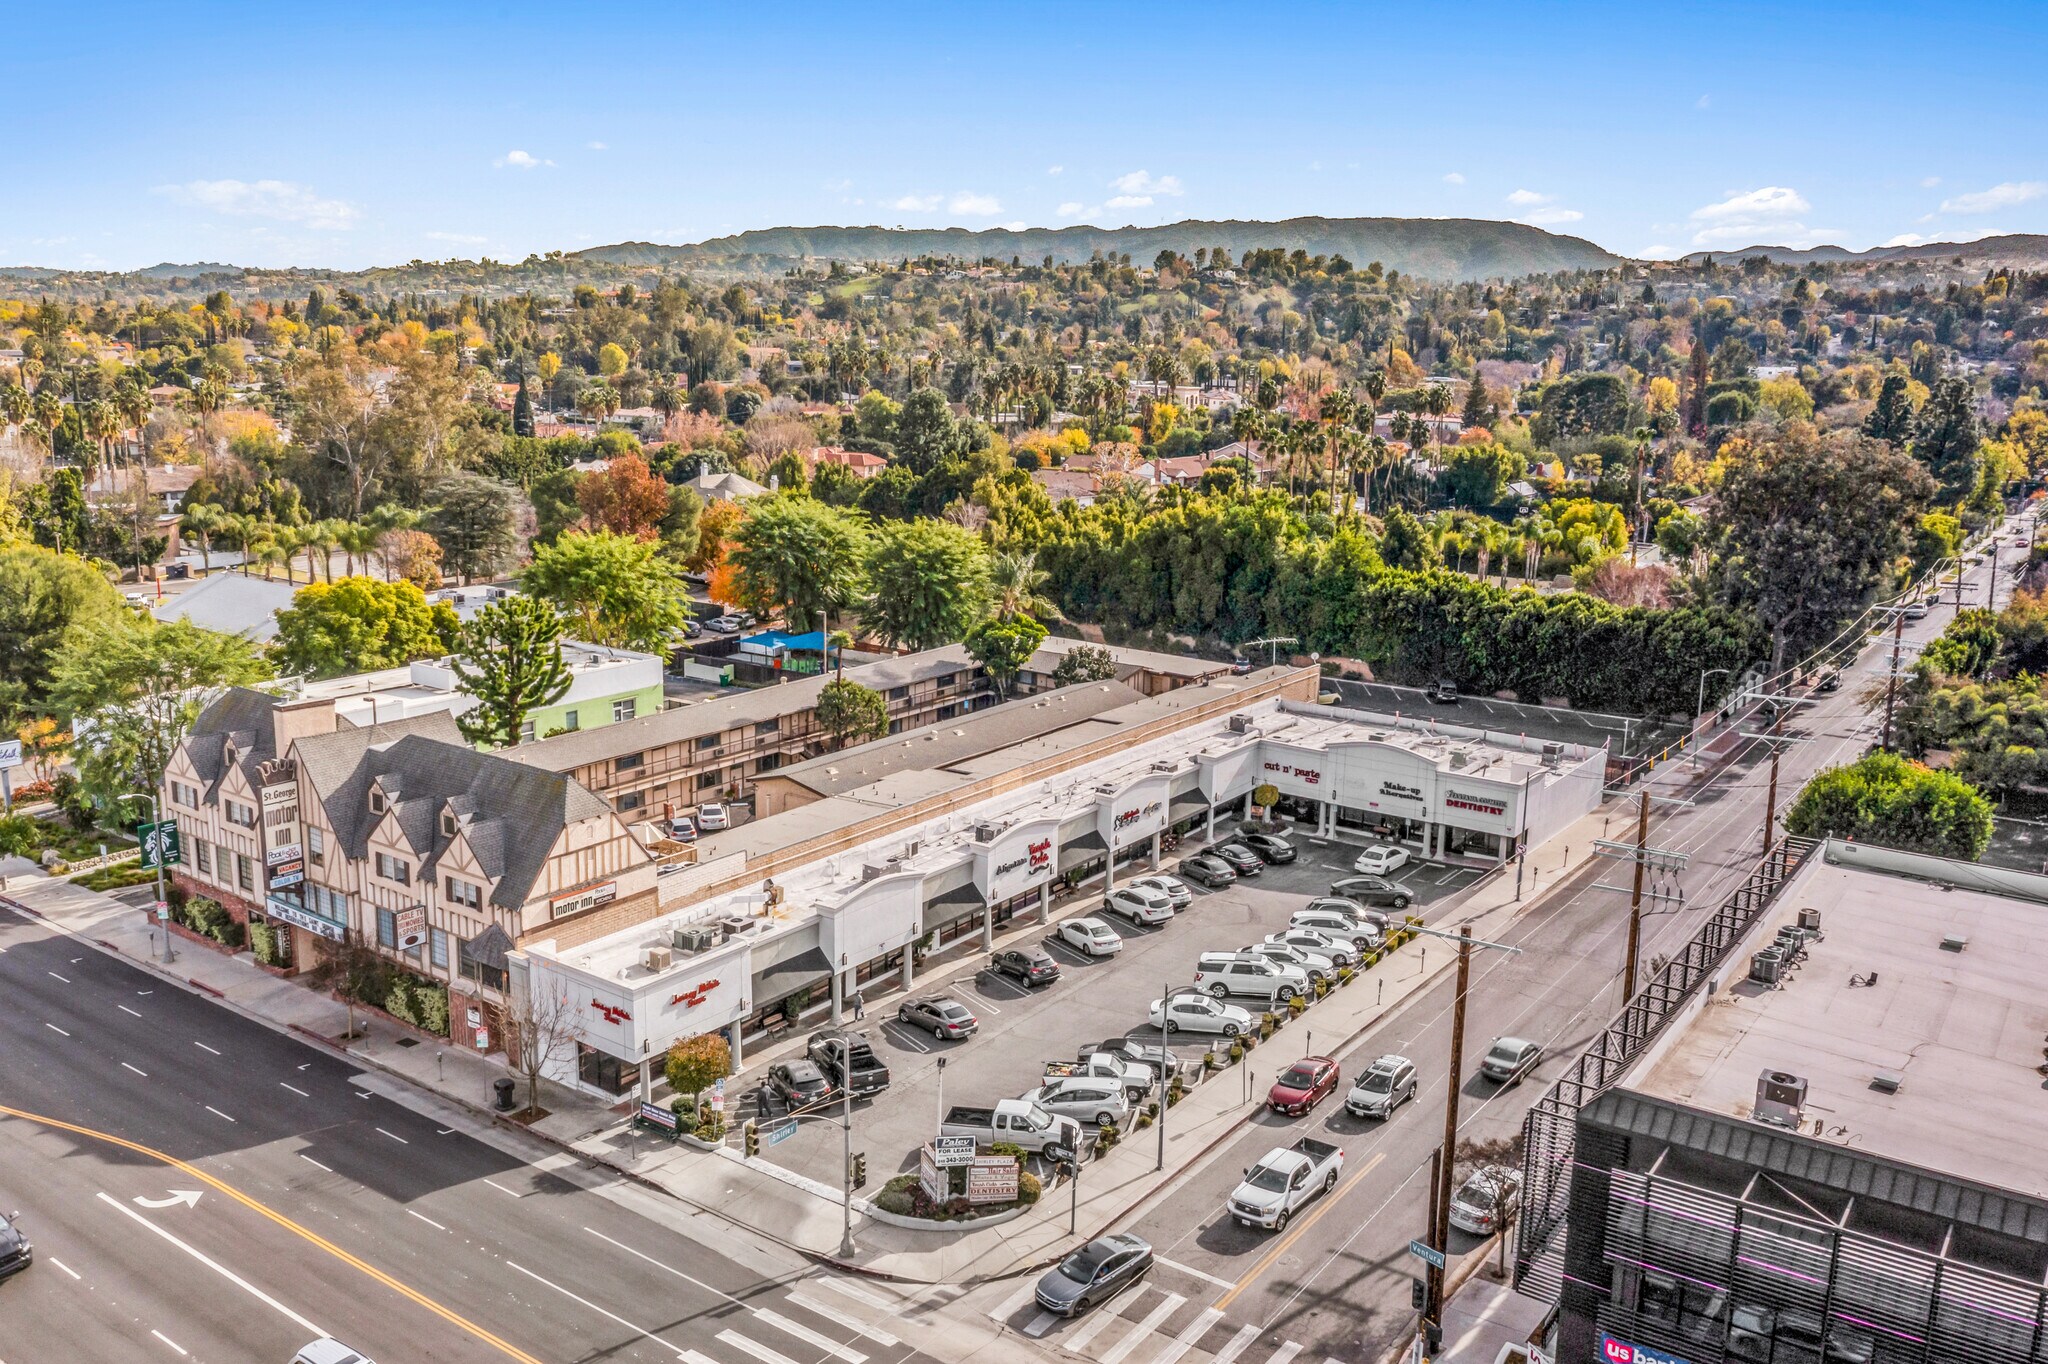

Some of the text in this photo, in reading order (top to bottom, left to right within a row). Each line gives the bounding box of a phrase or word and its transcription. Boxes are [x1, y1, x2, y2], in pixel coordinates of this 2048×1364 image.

[1264, 762, 1320, 779] cut n' paste
[274, 788, 296, 799] George
[1379, 788, 1424, 801] Alternatives
[1383, 781, 1421, 795] Make-up
[1446, 799, 1504, 815] DENTISTRY
[265, 804, 298, 828] motor
[268, 851, 282, 860] Pool
[285, 851, 300, 861] Spa
[279, 863, 301, 873] VACANCY
[274, 904, 289, 914] WELCOME
[555, 900, 579, 916] motor
[397, 908, 424, 922] CABLE TV
[405, 917, 424, 927] MOVIES
[402, 924, 424, 935] SPORTS
[772, 1125, 795, 1142] Shirley
[942, 1138, 970, 1147] Paley
[1412, 1243, 1442, 1265] Ventura
[1607, 1343, 1630, 1361] us
